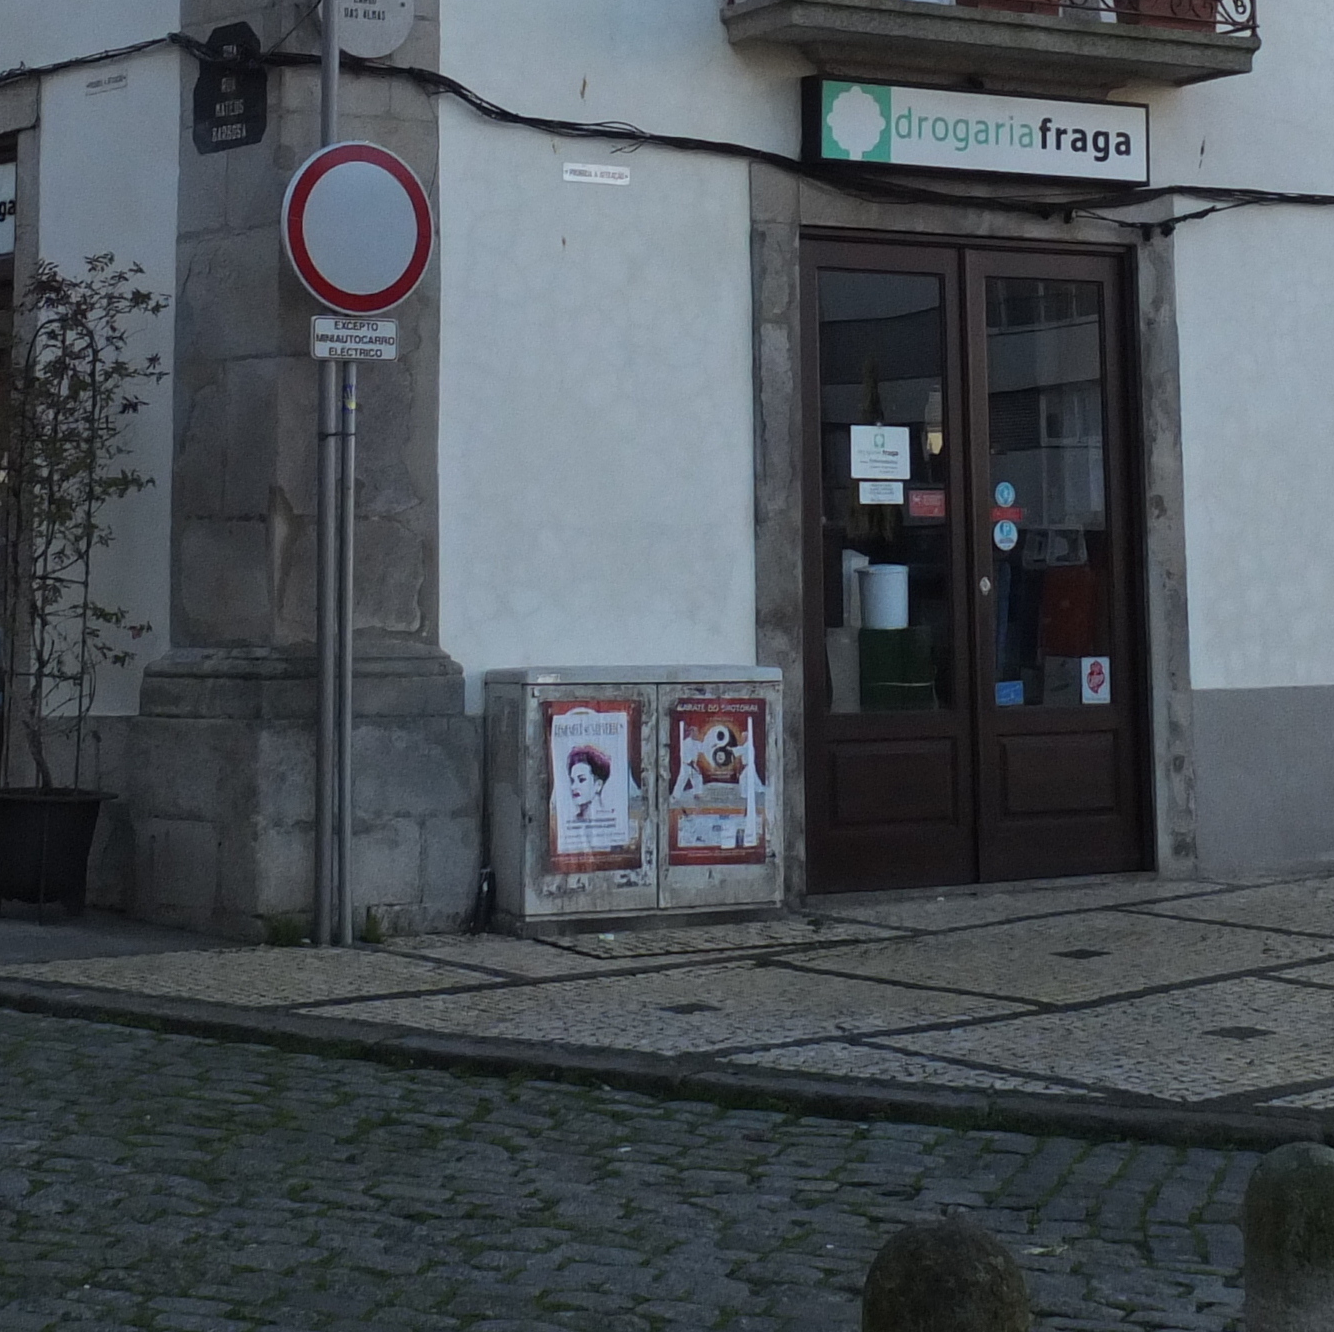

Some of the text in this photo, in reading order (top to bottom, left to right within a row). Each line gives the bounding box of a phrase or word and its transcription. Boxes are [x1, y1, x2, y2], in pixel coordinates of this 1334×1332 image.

[212, 124, 246, 142] BARBOSA
[334, 320, 379, 332] EXCEPTO
[315, 333, 395, 346] MINIAUTOCARRO
